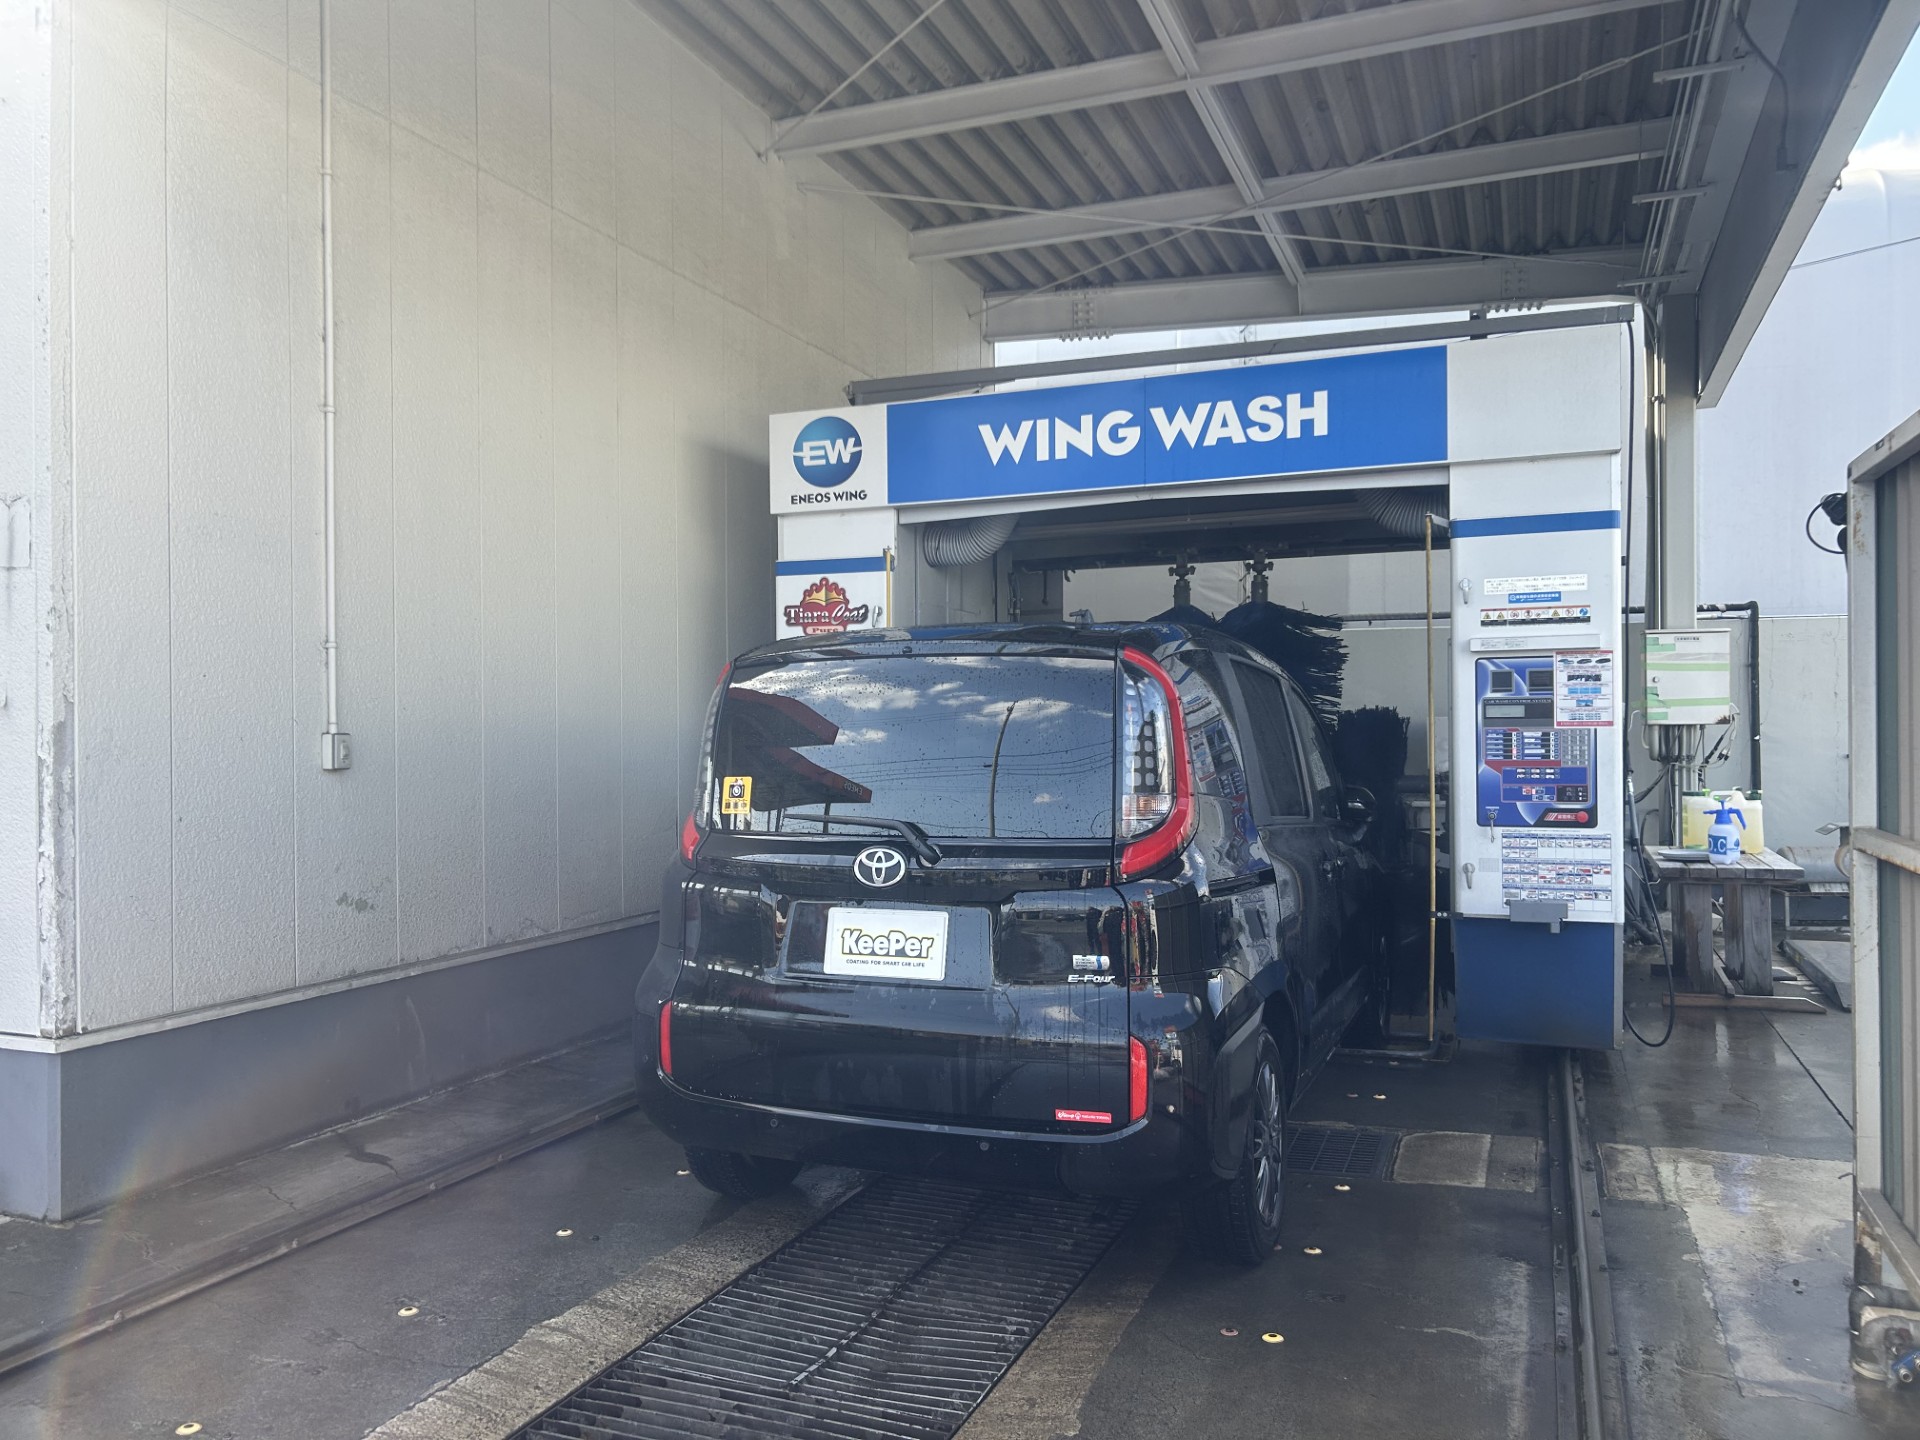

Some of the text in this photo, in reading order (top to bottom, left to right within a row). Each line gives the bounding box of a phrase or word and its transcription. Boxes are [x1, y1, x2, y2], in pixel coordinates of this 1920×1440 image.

[978, 389, 1329, 466] WING WASH
[802, 437, 856, 467] EW
[790, 490, 868, 505] ENEOS WING
[786, 603, 866, 625] Tiara Coat
[841, 928, 935, 959] KeePer
[1067, 974, 1116, 983] E-Four
